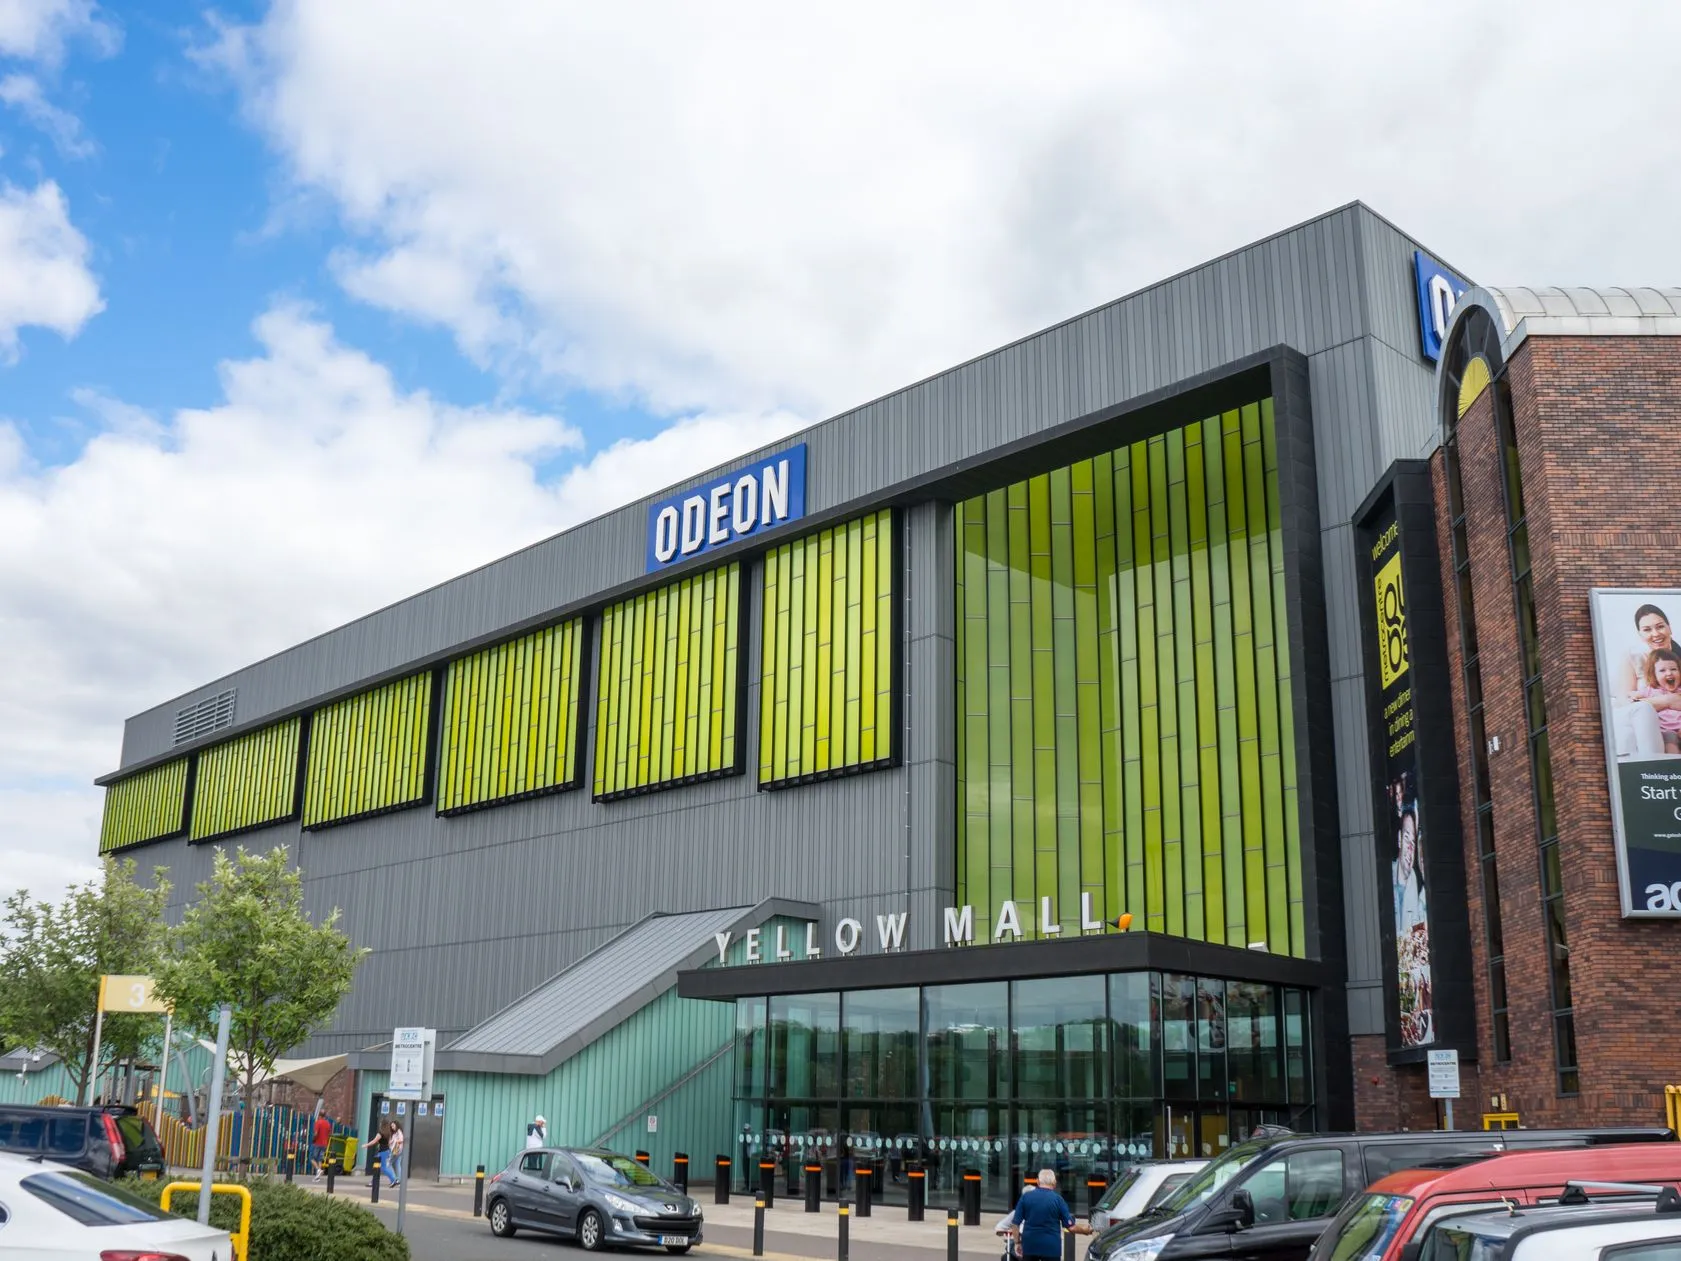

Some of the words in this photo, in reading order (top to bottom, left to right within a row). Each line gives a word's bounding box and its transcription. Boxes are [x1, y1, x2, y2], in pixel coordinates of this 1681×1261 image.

[1428, 274, 1463, 341] O
[655, 459, 789, 563] ODEON
[1371, 520, 1398, 561] welcome
[1640, 773, 1670, 781] Thinking
[1641, 785, 1678, 800] Start
[715, 912, 910, 964] YELLOW
[944, 892, 1105, 943] MALL
[129, 982, 145, 1009] 3
